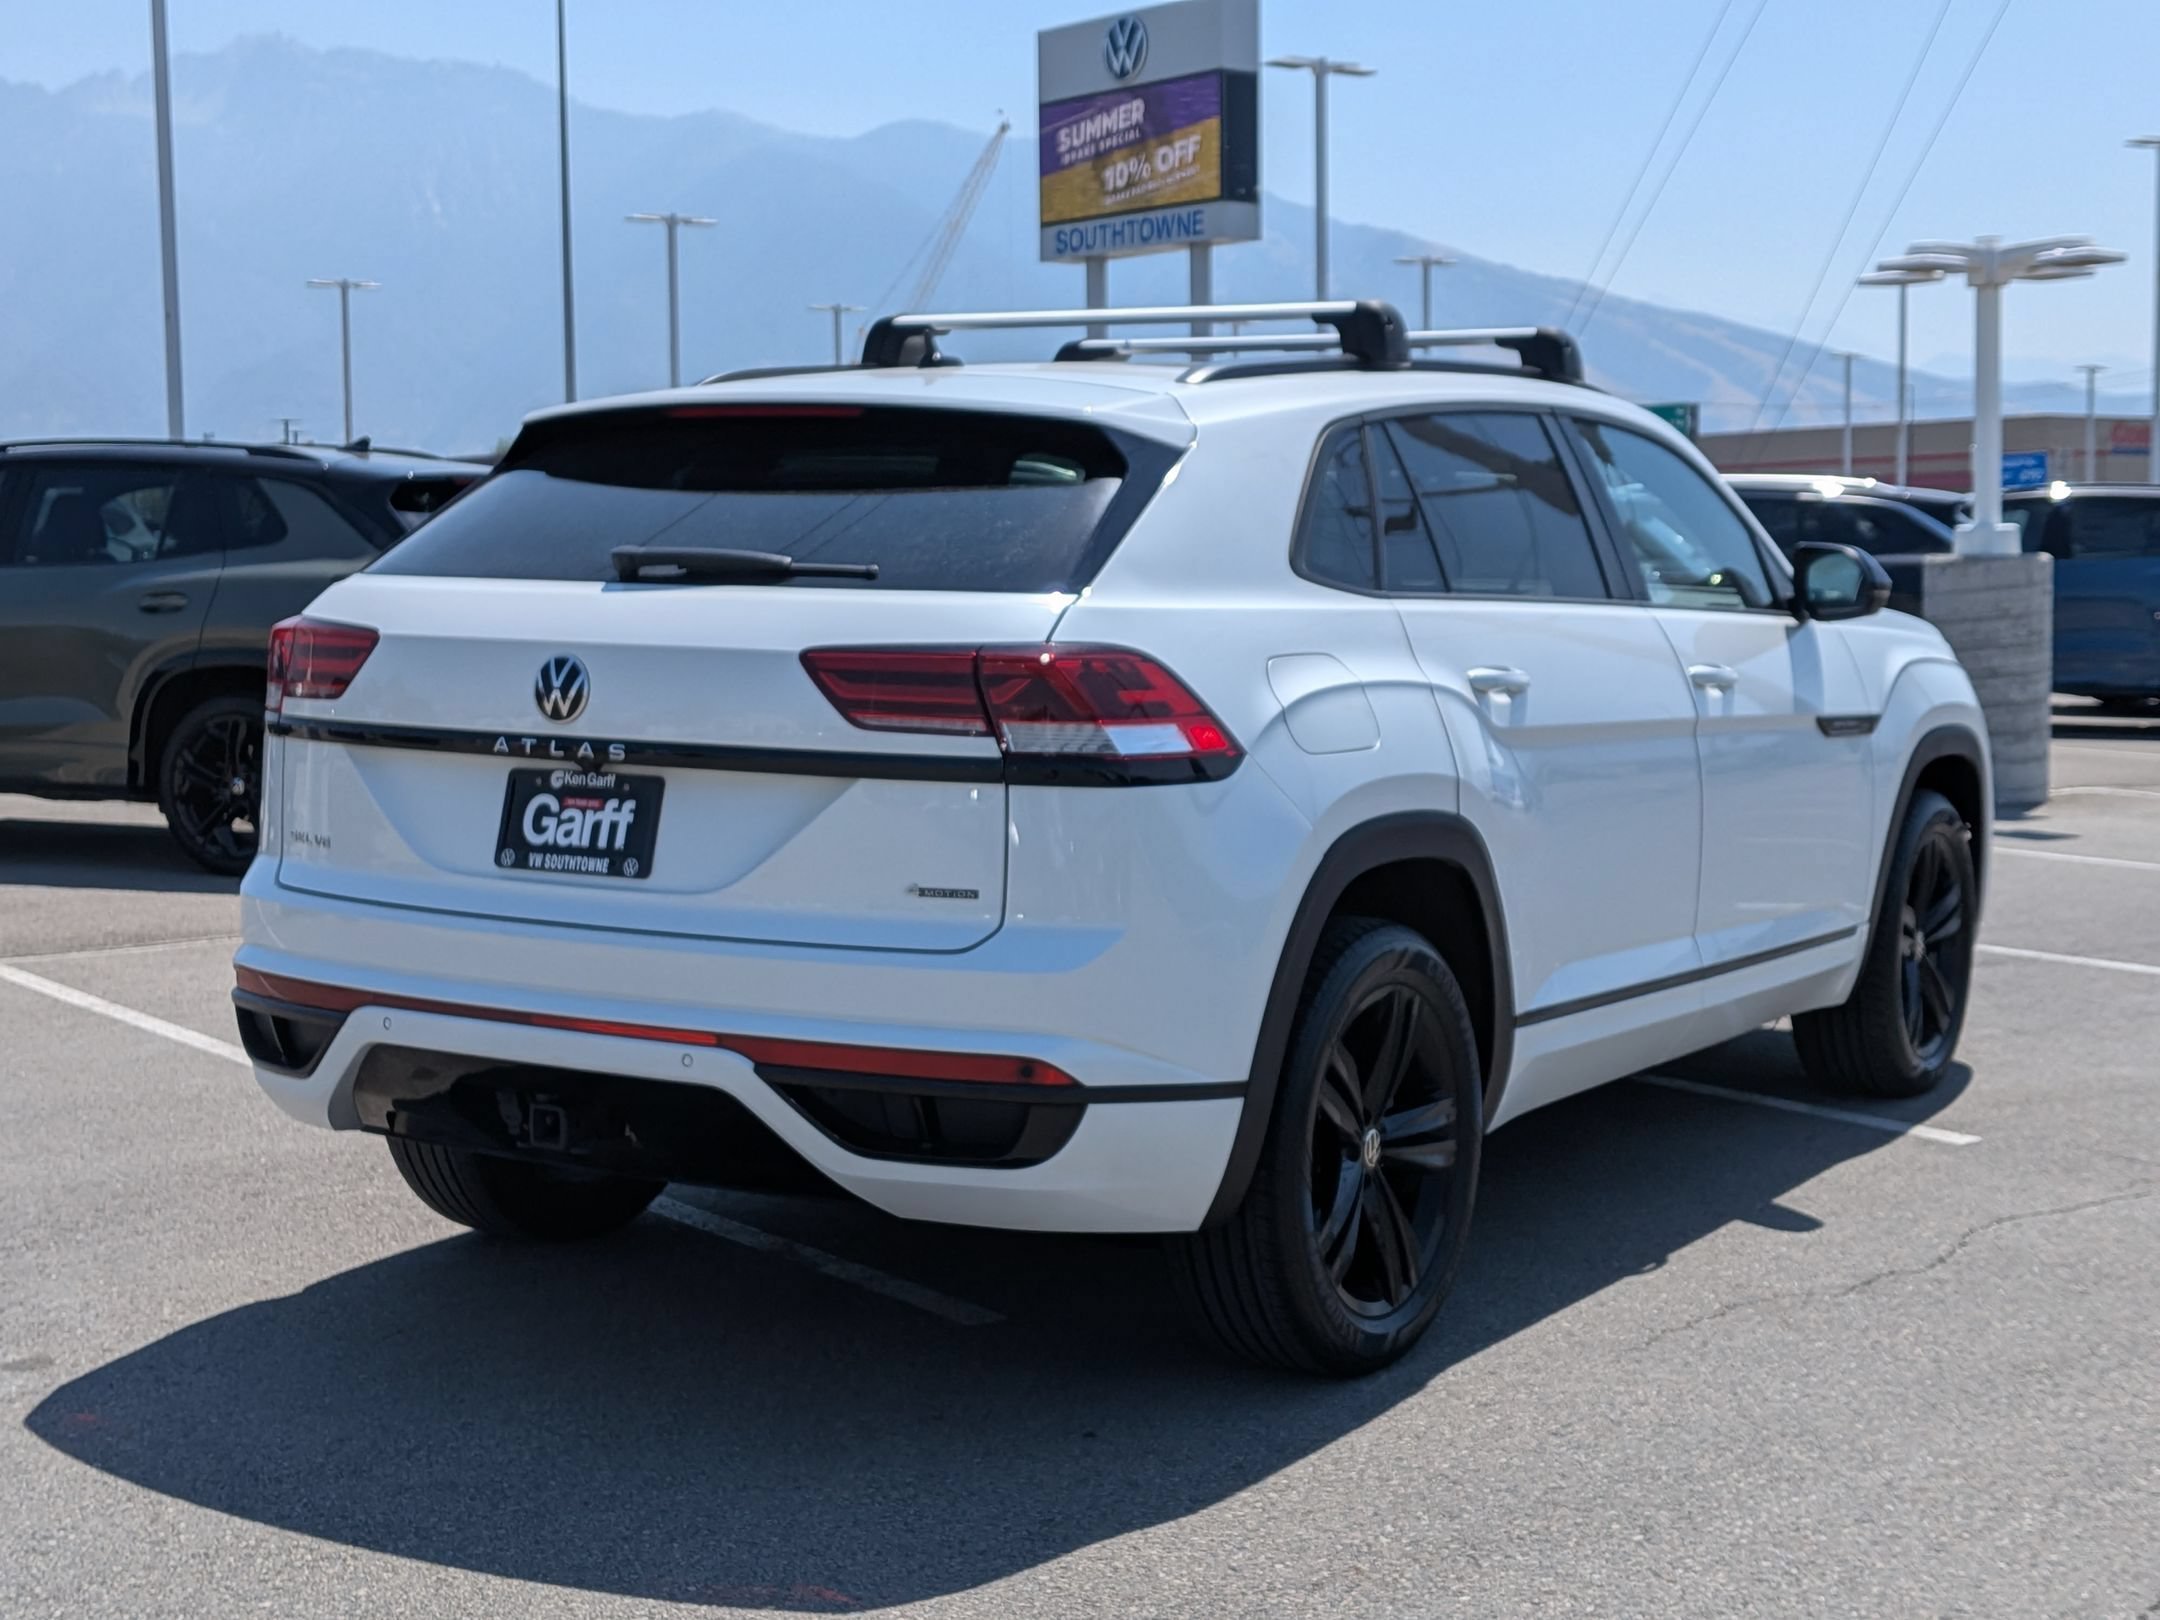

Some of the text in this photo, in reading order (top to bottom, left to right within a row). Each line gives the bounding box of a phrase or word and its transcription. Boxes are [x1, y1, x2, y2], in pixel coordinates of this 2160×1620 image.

[1057, 97, 1145, 153] SUMMER
[1099, 127, 1141, 153] SPECIAL
[1103, 152, 1152, 193] 10%
[1155, 134, 1201, 173] OFF
[1056, 210, 1205, 254] SOUTHTOWNE
[493, 736, 626, 761] ATLAS
[565, 770, 586, 786] Ken
[587, 772, 616, 788] Garff
[522, 793, 636, 849] Garff
[528, 852, 610, 873] VW SOUTHTOWNE
